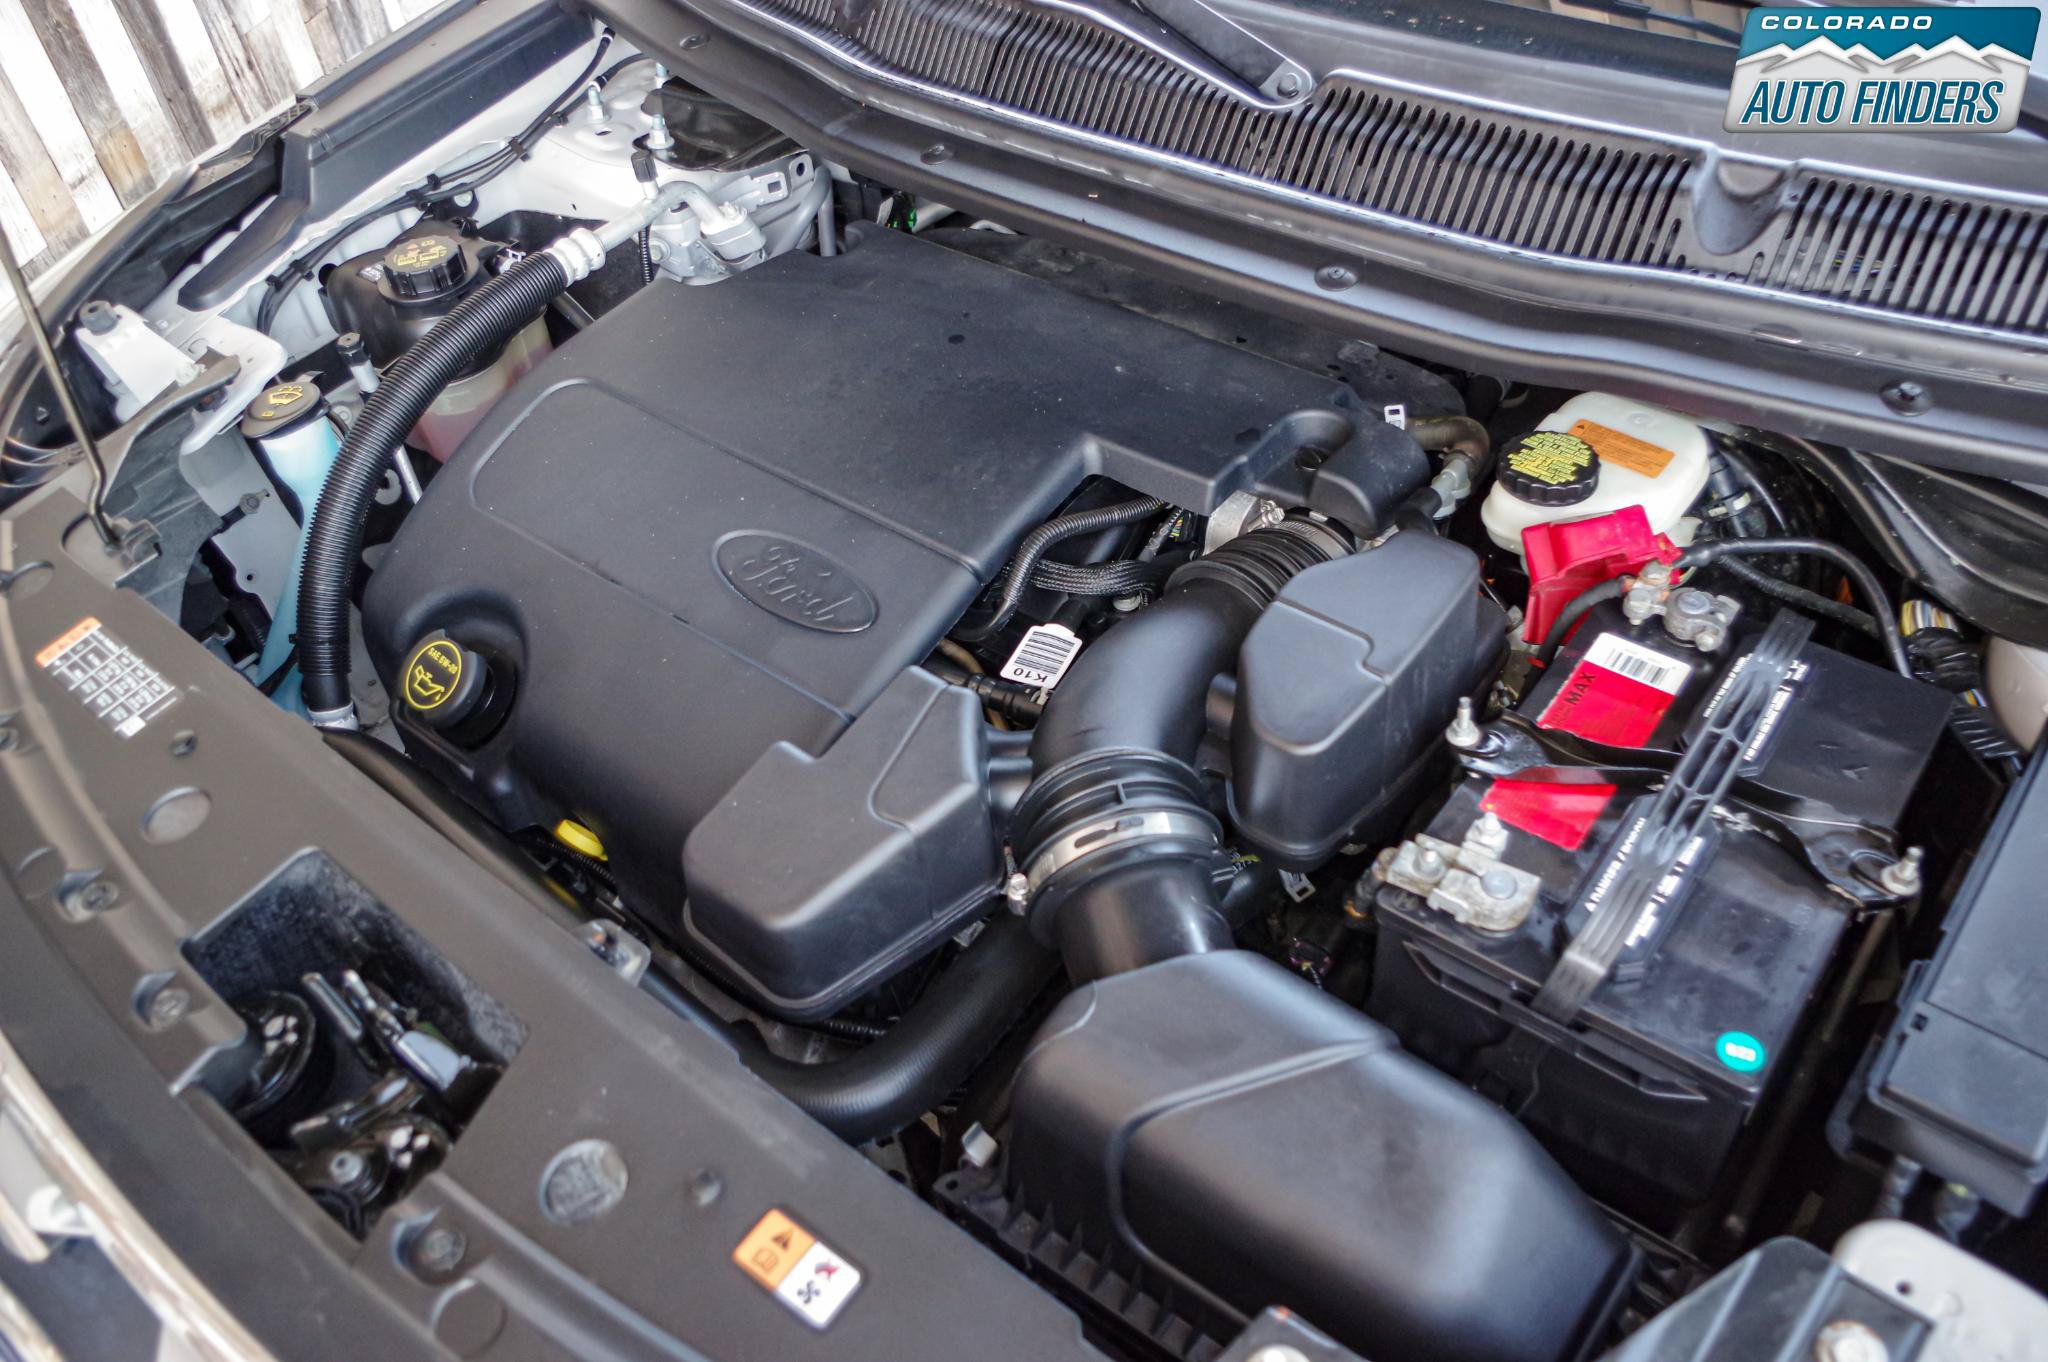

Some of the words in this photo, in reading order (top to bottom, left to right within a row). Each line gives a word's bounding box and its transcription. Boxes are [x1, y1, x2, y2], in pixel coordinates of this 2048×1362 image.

[742, 546, 856, 622] Ford
[1013, 667, 1048, 683] K10
[1565, 672, 1597, 706] MAX
